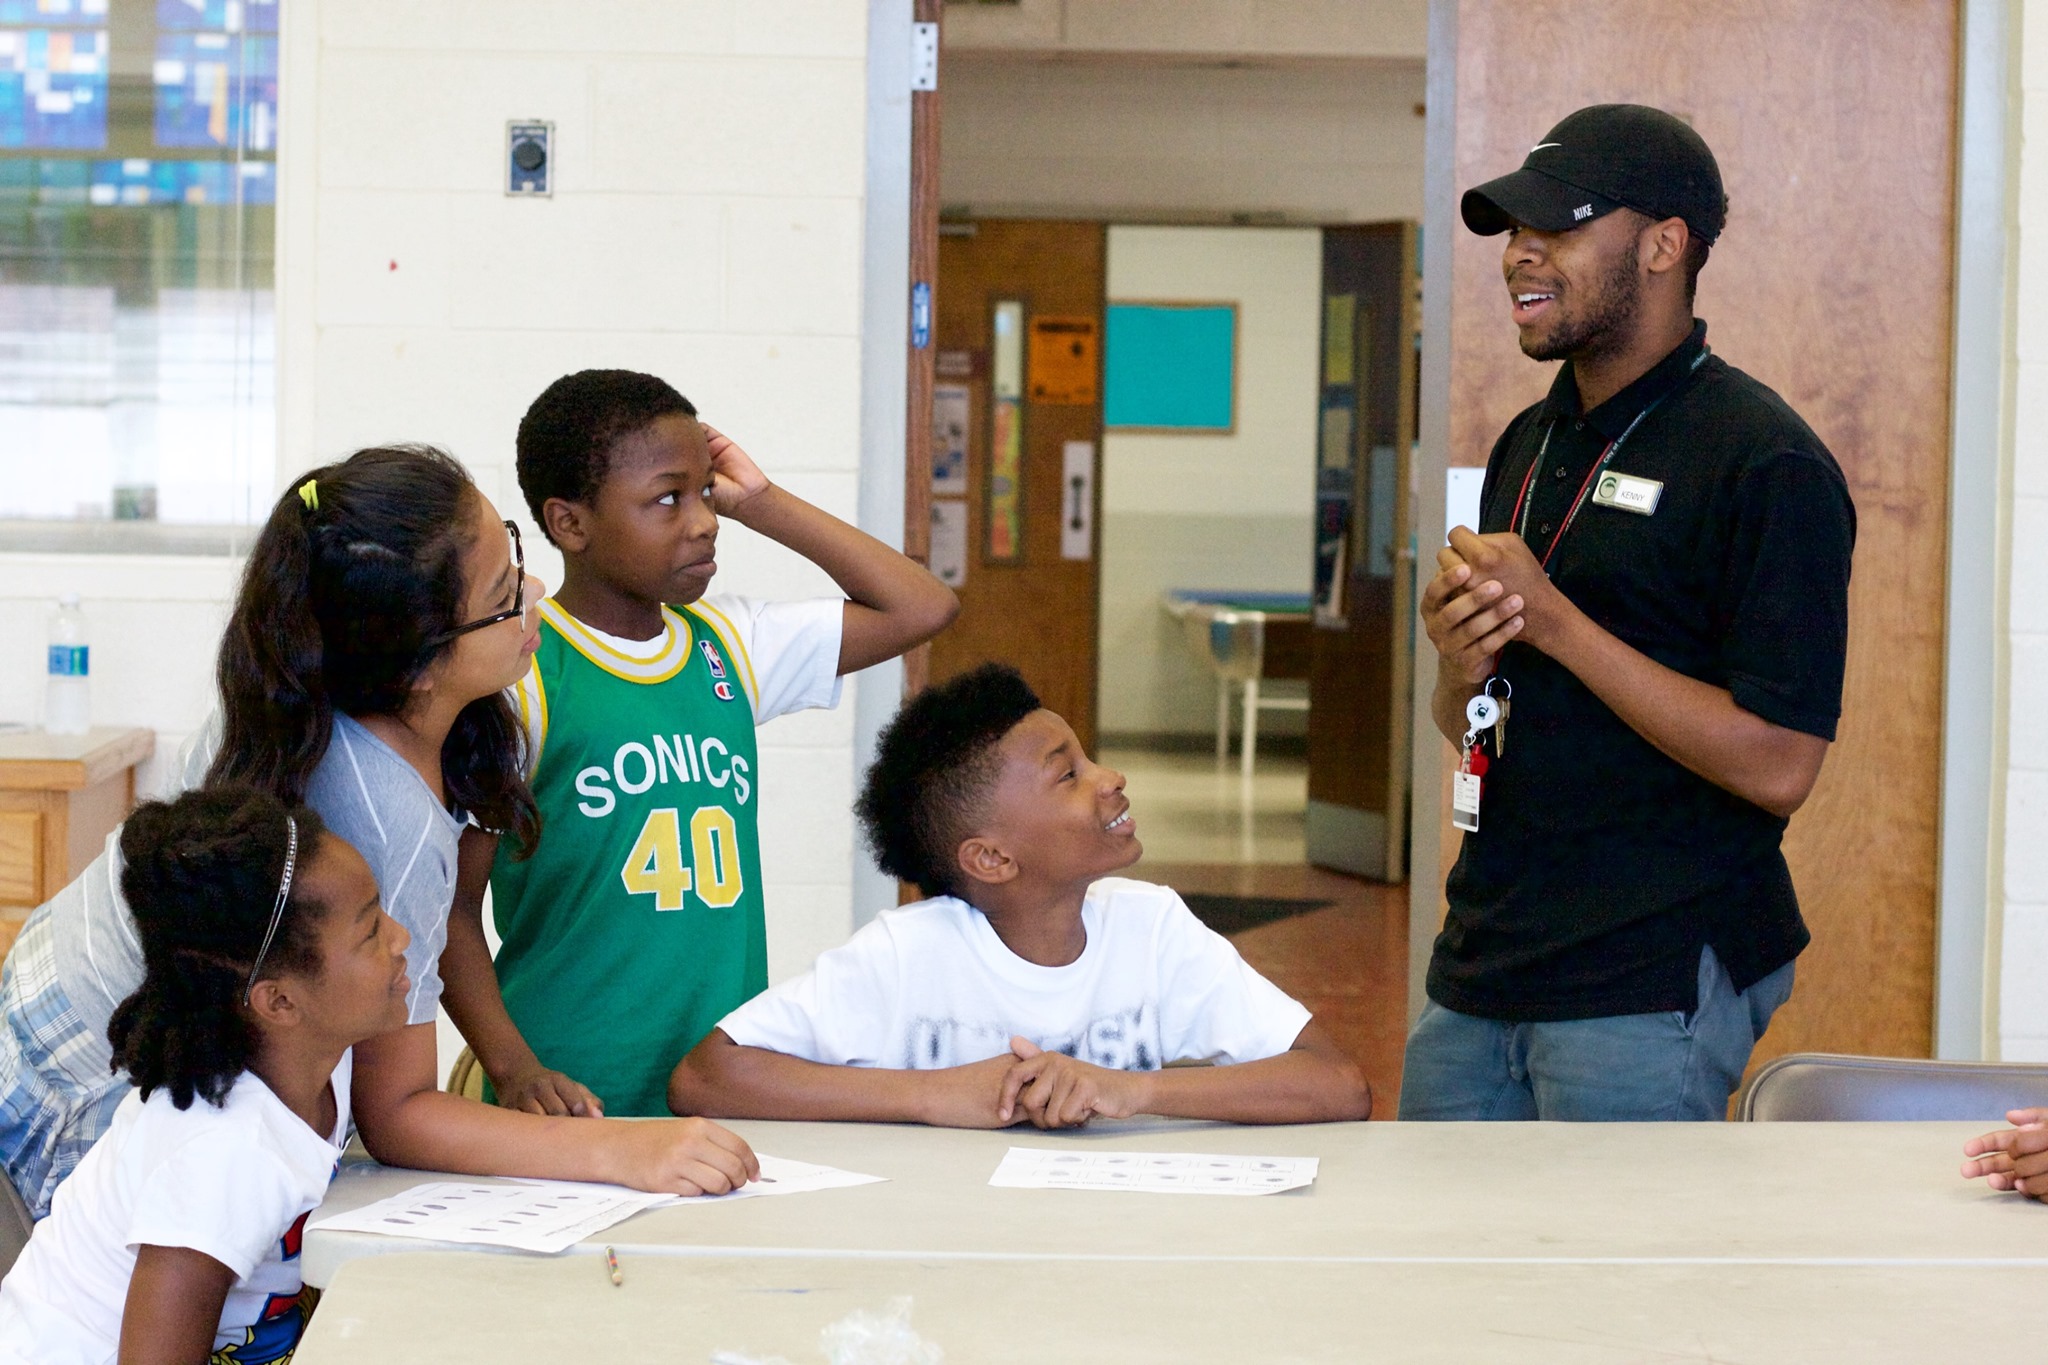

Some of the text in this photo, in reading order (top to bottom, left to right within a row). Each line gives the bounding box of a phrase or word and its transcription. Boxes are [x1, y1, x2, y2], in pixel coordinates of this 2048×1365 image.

[1573, 203, 1593, 221] NIKE
[1621, 490, 1646, 502] KENNY
[575, 734, 750, 818] SONICS
[620, 805, 744, 911] 40
